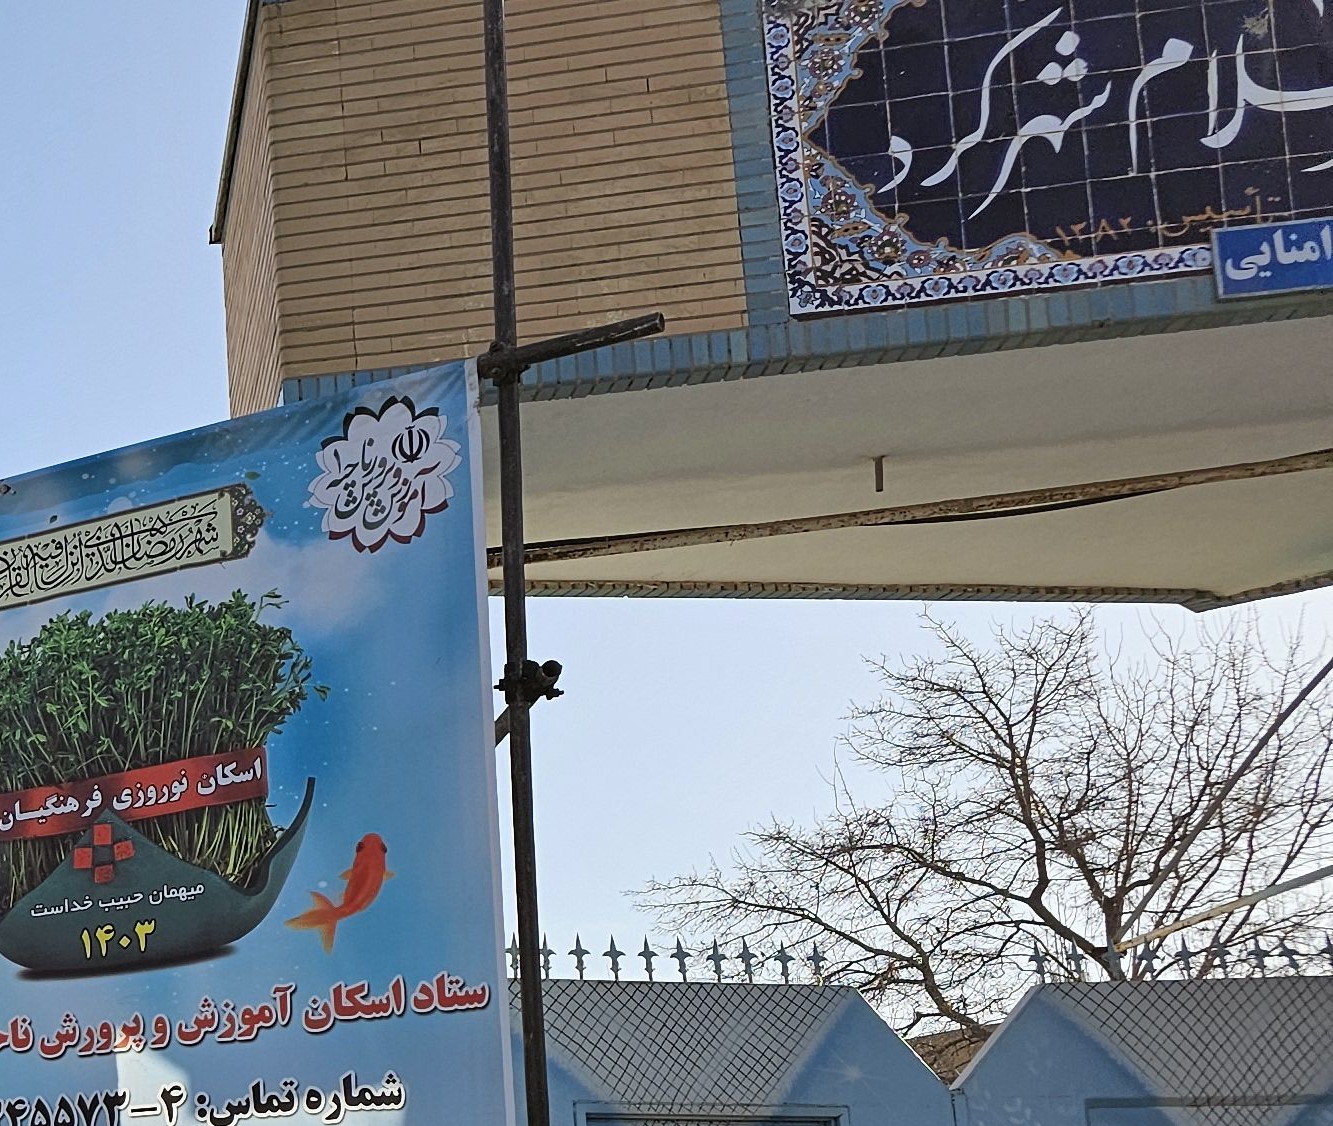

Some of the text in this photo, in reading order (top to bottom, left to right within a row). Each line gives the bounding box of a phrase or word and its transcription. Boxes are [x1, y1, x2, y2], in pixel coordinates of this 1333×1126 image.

[877, 7, 1112, 220] شهرکرد
[112, 769, 189, 811] نوروزی
[197, 757, 263, 795] اسکان
[30, 882, 205, 917] میهمان حبیب خداست
[81, 919, 156, 959] ۱۴۰۳
[177, 983, 296, 1043] آموزش
[303, 976, 406, 1032] اسکان
[412, 972, 489, 1012] ستاد
[38, 1012, 144, 1057] پرورش
[150, 1012, 171, 1048] و
[304, 1070, 407, 1124] شماره
